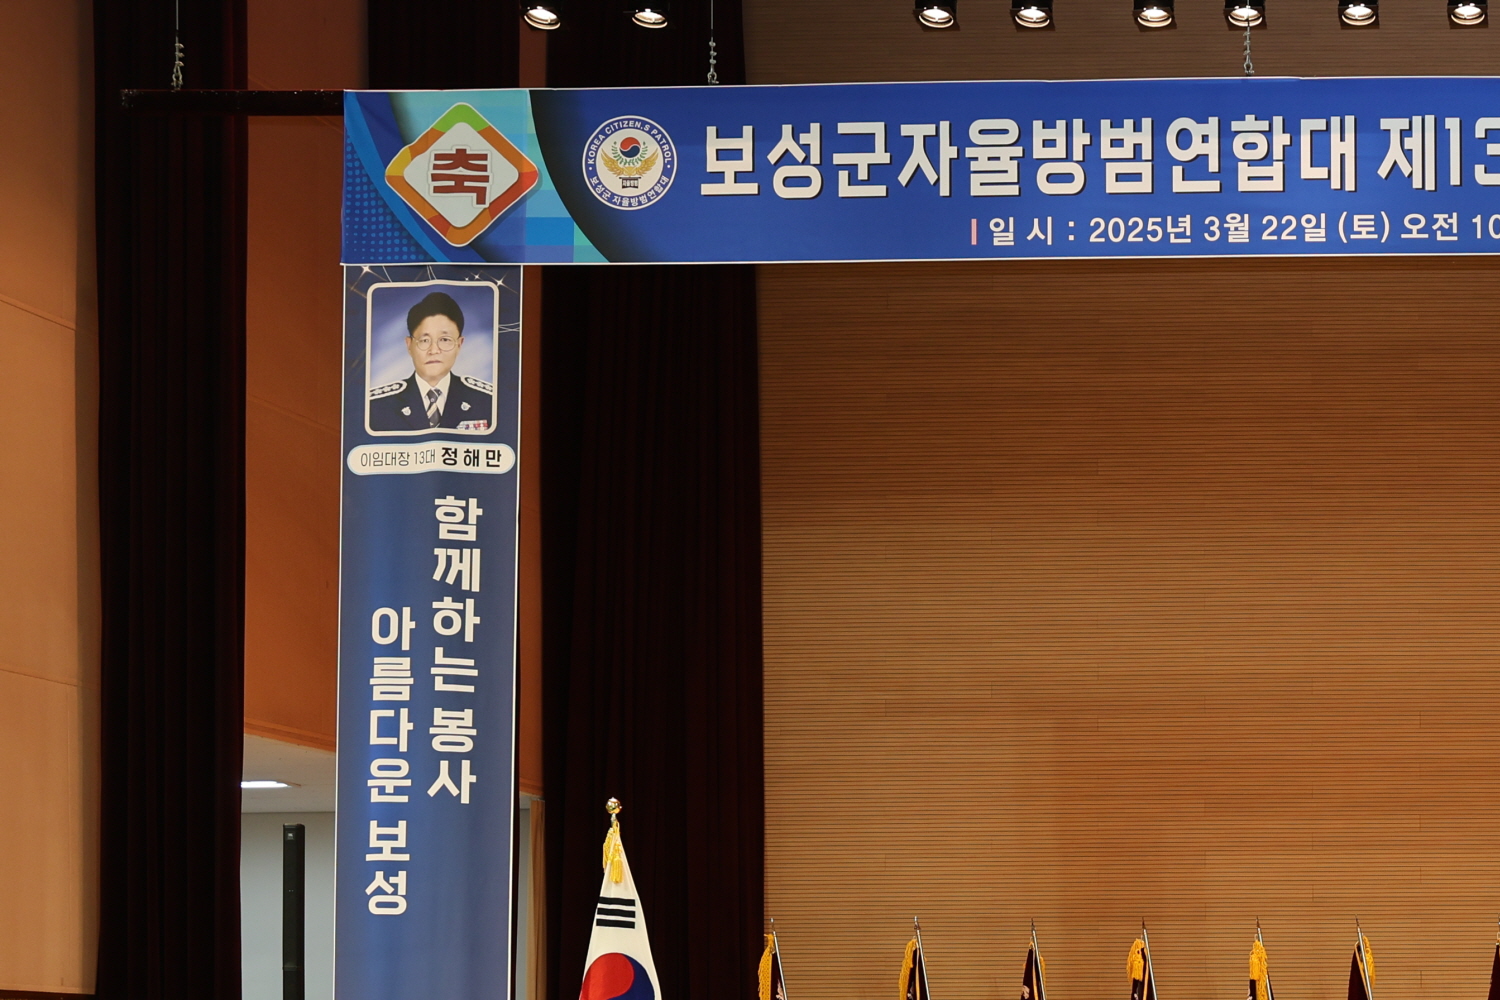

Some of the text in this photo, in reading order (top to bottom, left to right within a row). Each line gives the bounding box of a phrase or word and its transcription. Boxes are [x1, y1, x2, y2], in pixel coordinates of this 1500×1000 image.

[588, 134, 605, 164] KOREA
[651, 129, 672, 163] PATROL
[700, 114, 1356, 199] 보성군자율방범연합대
[432, 148, 489, 208] 축
[590, 176, 612, 200] 보성군
[1089, 213, 1192, 244] 2025년
[1204, 213, 1250, 243] 3월
[1261, 212, 1327, 241] 22일
[1338, 212, 1391, 244] (토)
[1401, 213, 1460, 241] 오전
[360, 451, 411, 468] 이임대장
[414, 449, 436, 465] 13대
[427, 495, 483, 804] 함께하는 봉사
[365, 607, 415, 915] 아름다운 보성
